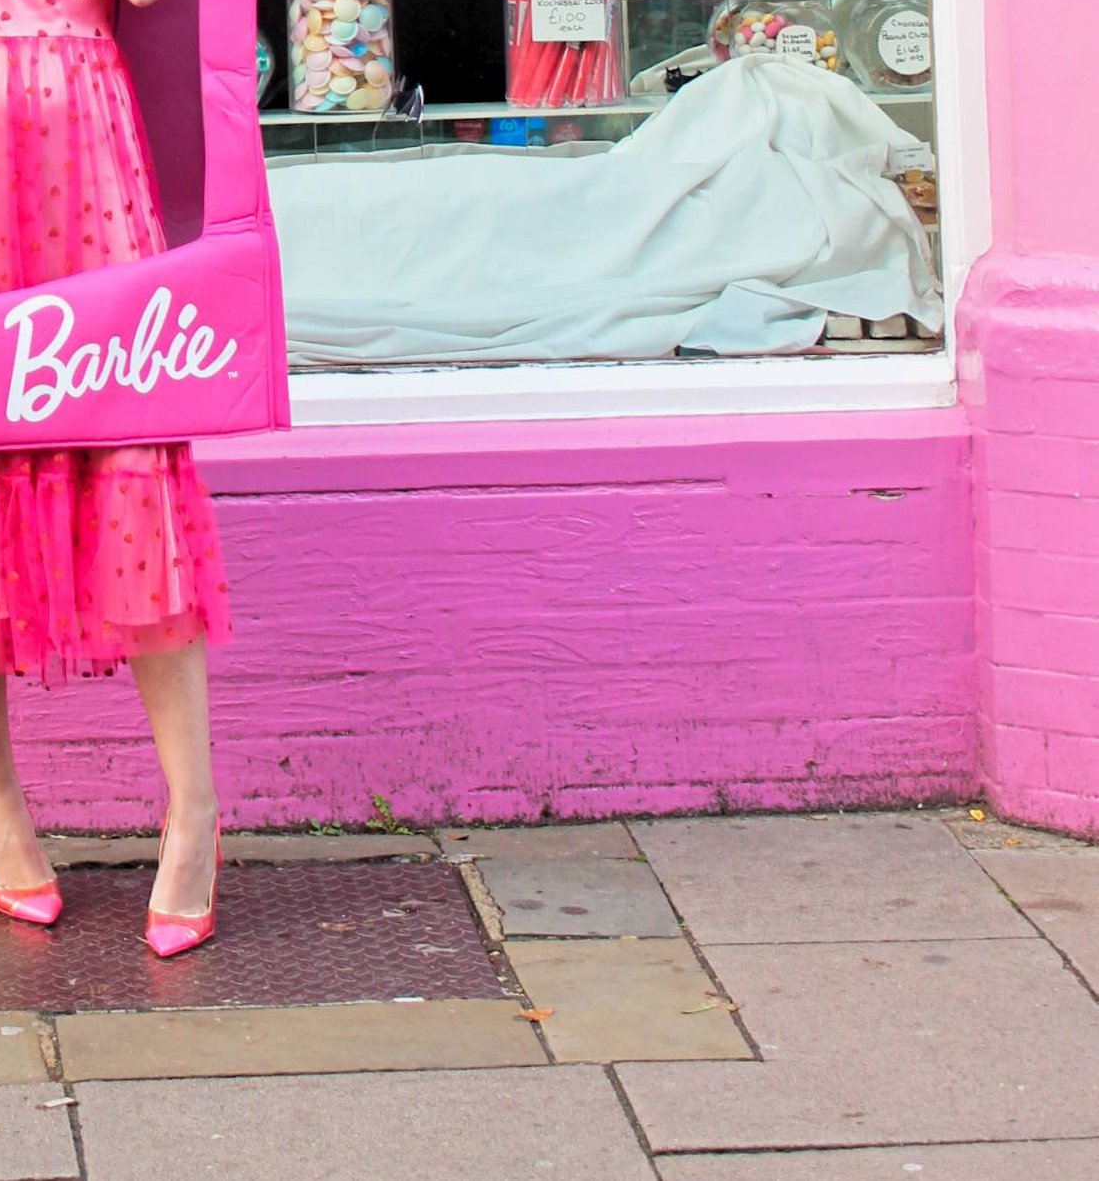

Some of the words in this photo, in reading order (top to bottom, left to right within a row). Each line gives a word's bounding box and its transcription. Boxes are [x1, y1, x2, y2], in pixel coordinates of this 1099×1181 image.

[560, 24, 584, 33] each
[881, 31, 906, 41] Peanut
[4, 286, 238, 423] Barbie
